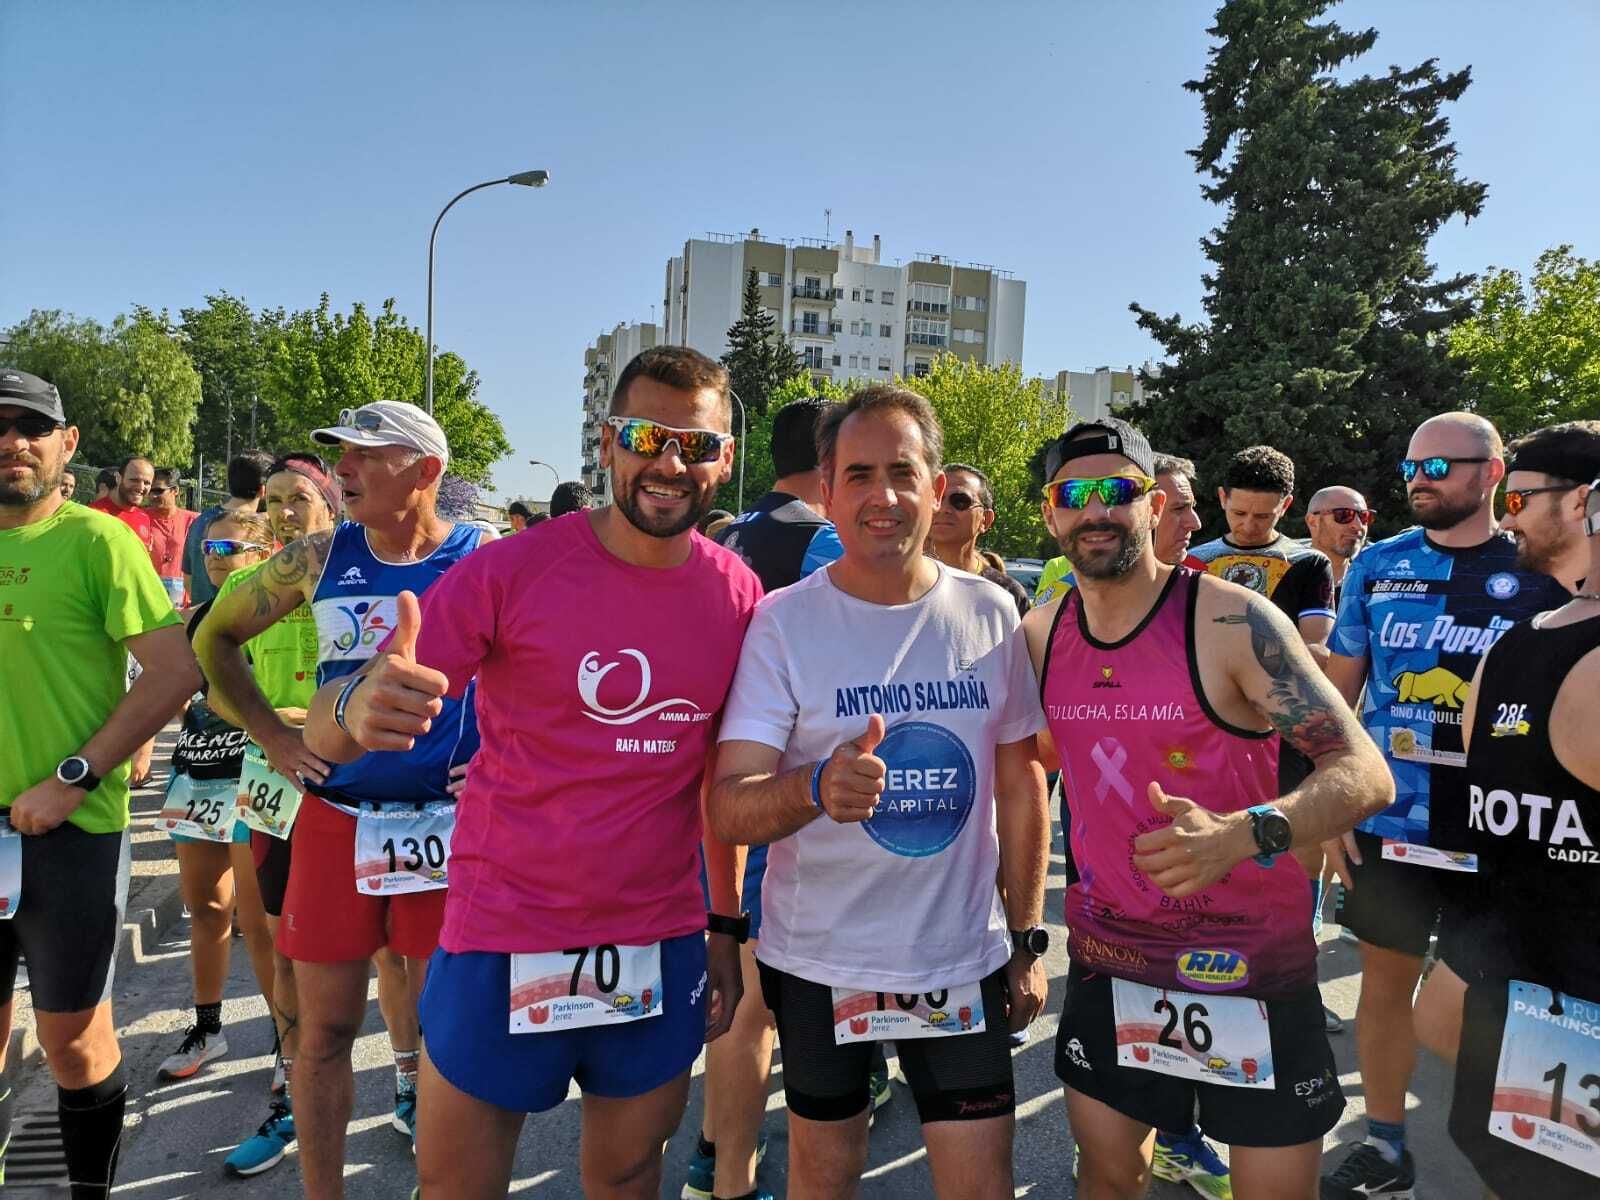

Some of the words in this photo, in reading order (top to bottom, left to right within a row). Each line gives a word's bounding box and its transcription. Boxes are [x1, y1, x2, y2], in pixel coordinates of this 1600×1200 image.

[836, 684, 911, 717] ANTONIO
[914, 675, 990, 712] SALDAÑA
[658, 712, 690, 722] AMMA
[1048, 705, 1060, 719] TU
[1061, 704, 1112, 720] LUCHA,
[1114, 705, 1128, 720] ES
[1131, 705, 1148, 720] LA
[1151, 702, 1185, 720] MÍA
[1390, 705, 1413, 719] RINO
[1415, 709, 1463, 725] ALQUILE
[1496, 703, 1527, 728] 28F
[616, 738, 640, 752] RAFA
[643, 740, 676, 753] MATEOS
[887, 768, 958, 790] EREZ
[248, 779, 284, 816] 184
[185, 798, 224, 825] 125
[1469, 784, 1593, 847] ROTA
[383, 835, 445, 872] 130
[1547, 847, 1600, 864] CADIZ
[563, 944, 620, 996] 70
[1186, 952, 1239, 973] RM
[552, 1001, 594, 1013] Parkinson
[871, 1016, 910, 1025] Parkinson
[1154, 1000, 1212, 1053] 26
[1152, 1048, 1188, 1063] Parkinson
[1539, 1125, 1592, 1151] Parkinson
